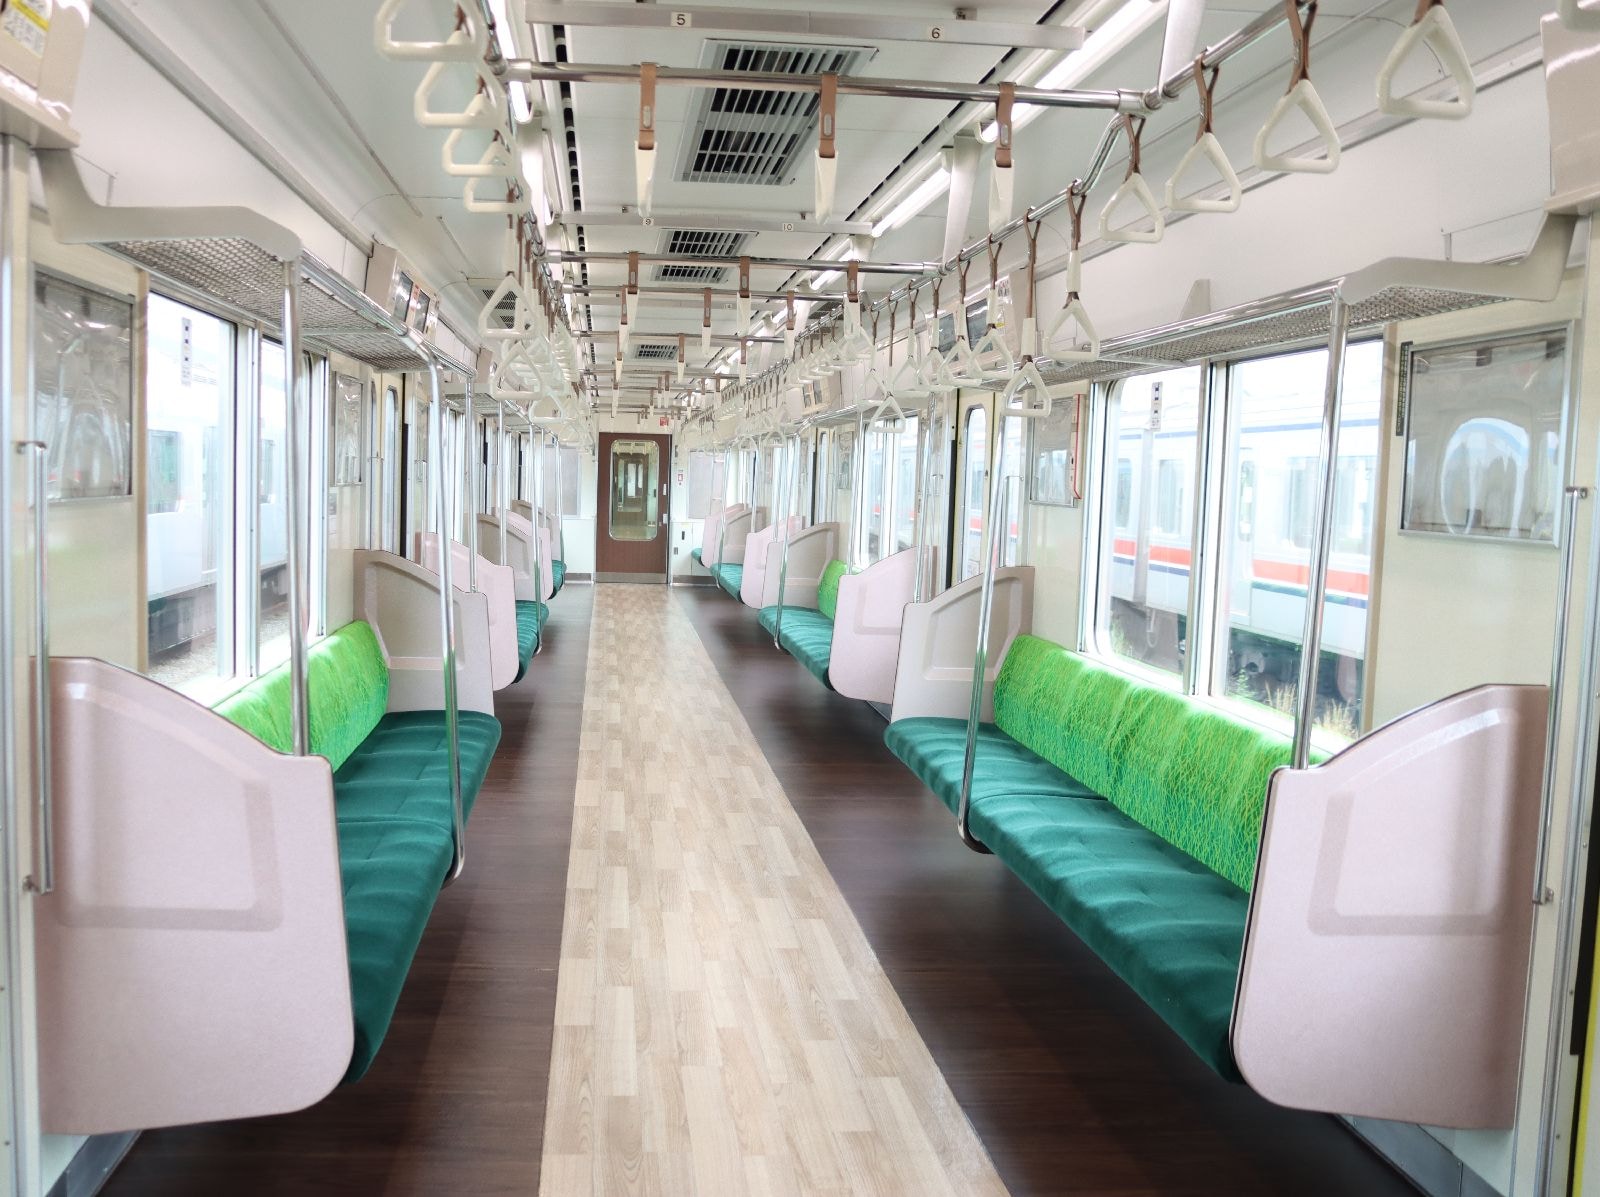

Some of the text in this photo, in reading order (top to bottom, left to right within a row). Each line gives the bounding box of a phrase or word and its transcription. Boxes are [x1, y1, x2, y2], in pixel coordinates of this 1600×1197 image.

[676, 14, 686, 25] 5
[931, 27, 941, 39] 6
[783, 223, 793, 231] 10
